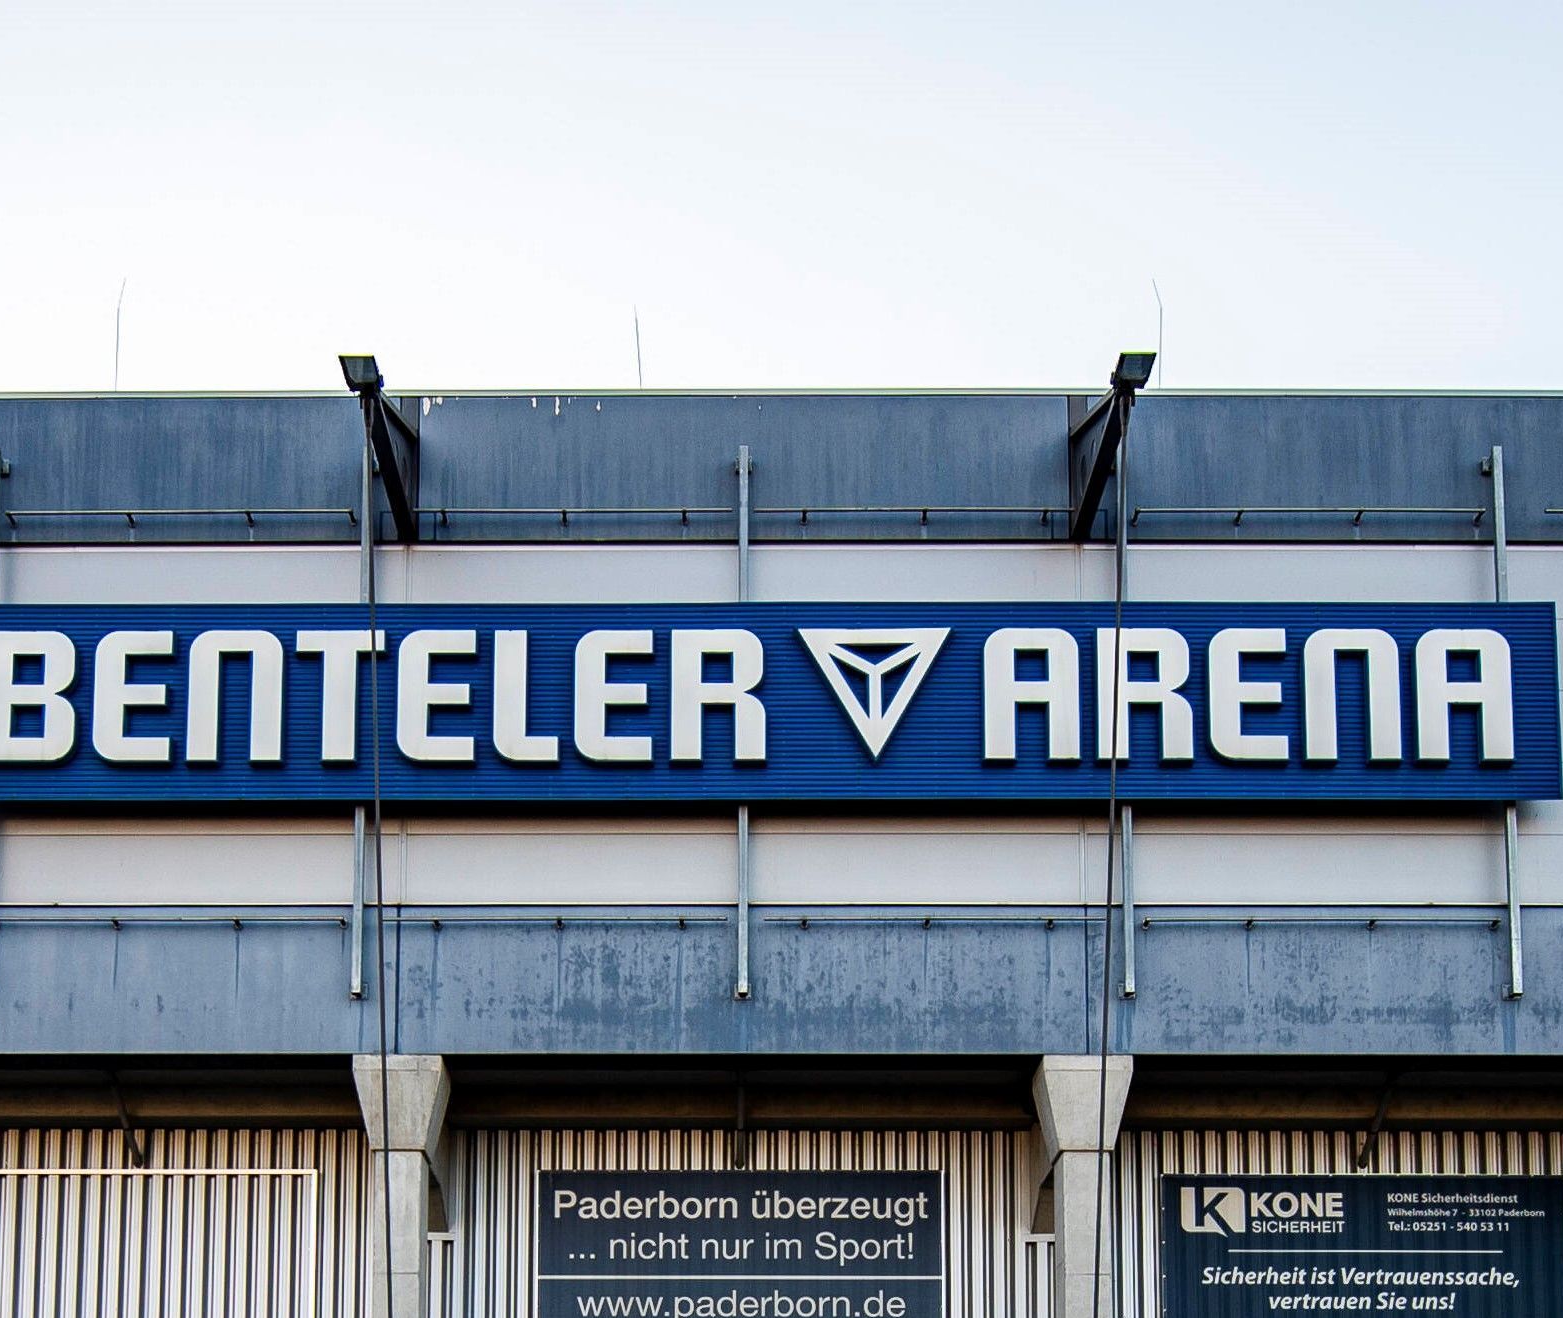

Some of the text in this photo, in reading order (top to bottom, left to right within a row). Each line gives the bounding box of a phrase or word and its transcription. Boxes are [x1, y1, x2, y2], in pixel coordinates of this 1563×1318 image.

[983, 627, 1515, 760] ARENA
[1250, 1191, 1344, 1218] KONE
[1387, 1192, 1519, 1204] KONE Sicherheitsdienst
[554, 1190, 929, 1227] Paderborn überzeugt
[1386, 1207, 1451, 1217] Wilhelmshöhe
[1452, 1208, 1458, 1217] 7
[1468, 1208, 1496, 1217] 33102
[1497, 1207, 1546, 1217] Paderborn
[1251, 1220, 1346, 1234] SICHERHEIT
[1387, 1220, 1411, 1232] Tel.:
[1412, 1221, 1447, 1232] 05251
[1456, 1221, 1477, 1232] 540
[1480, 1222, 1494, 1232] 53
[1497, 1222, 1510, 1232] 11
[609, 1232, 689, 1260] nicht
[701, 1236, 755, 1260] nur
[765, 1232, 803, 1260] im
[814, 1231, 914, 1267] Sport!
[1201, 1266, 1520, 1288] Sicherheit ist Vertrauenssache,
[1268, 1291, 1456, 1310] vertrauen Sie uns!
